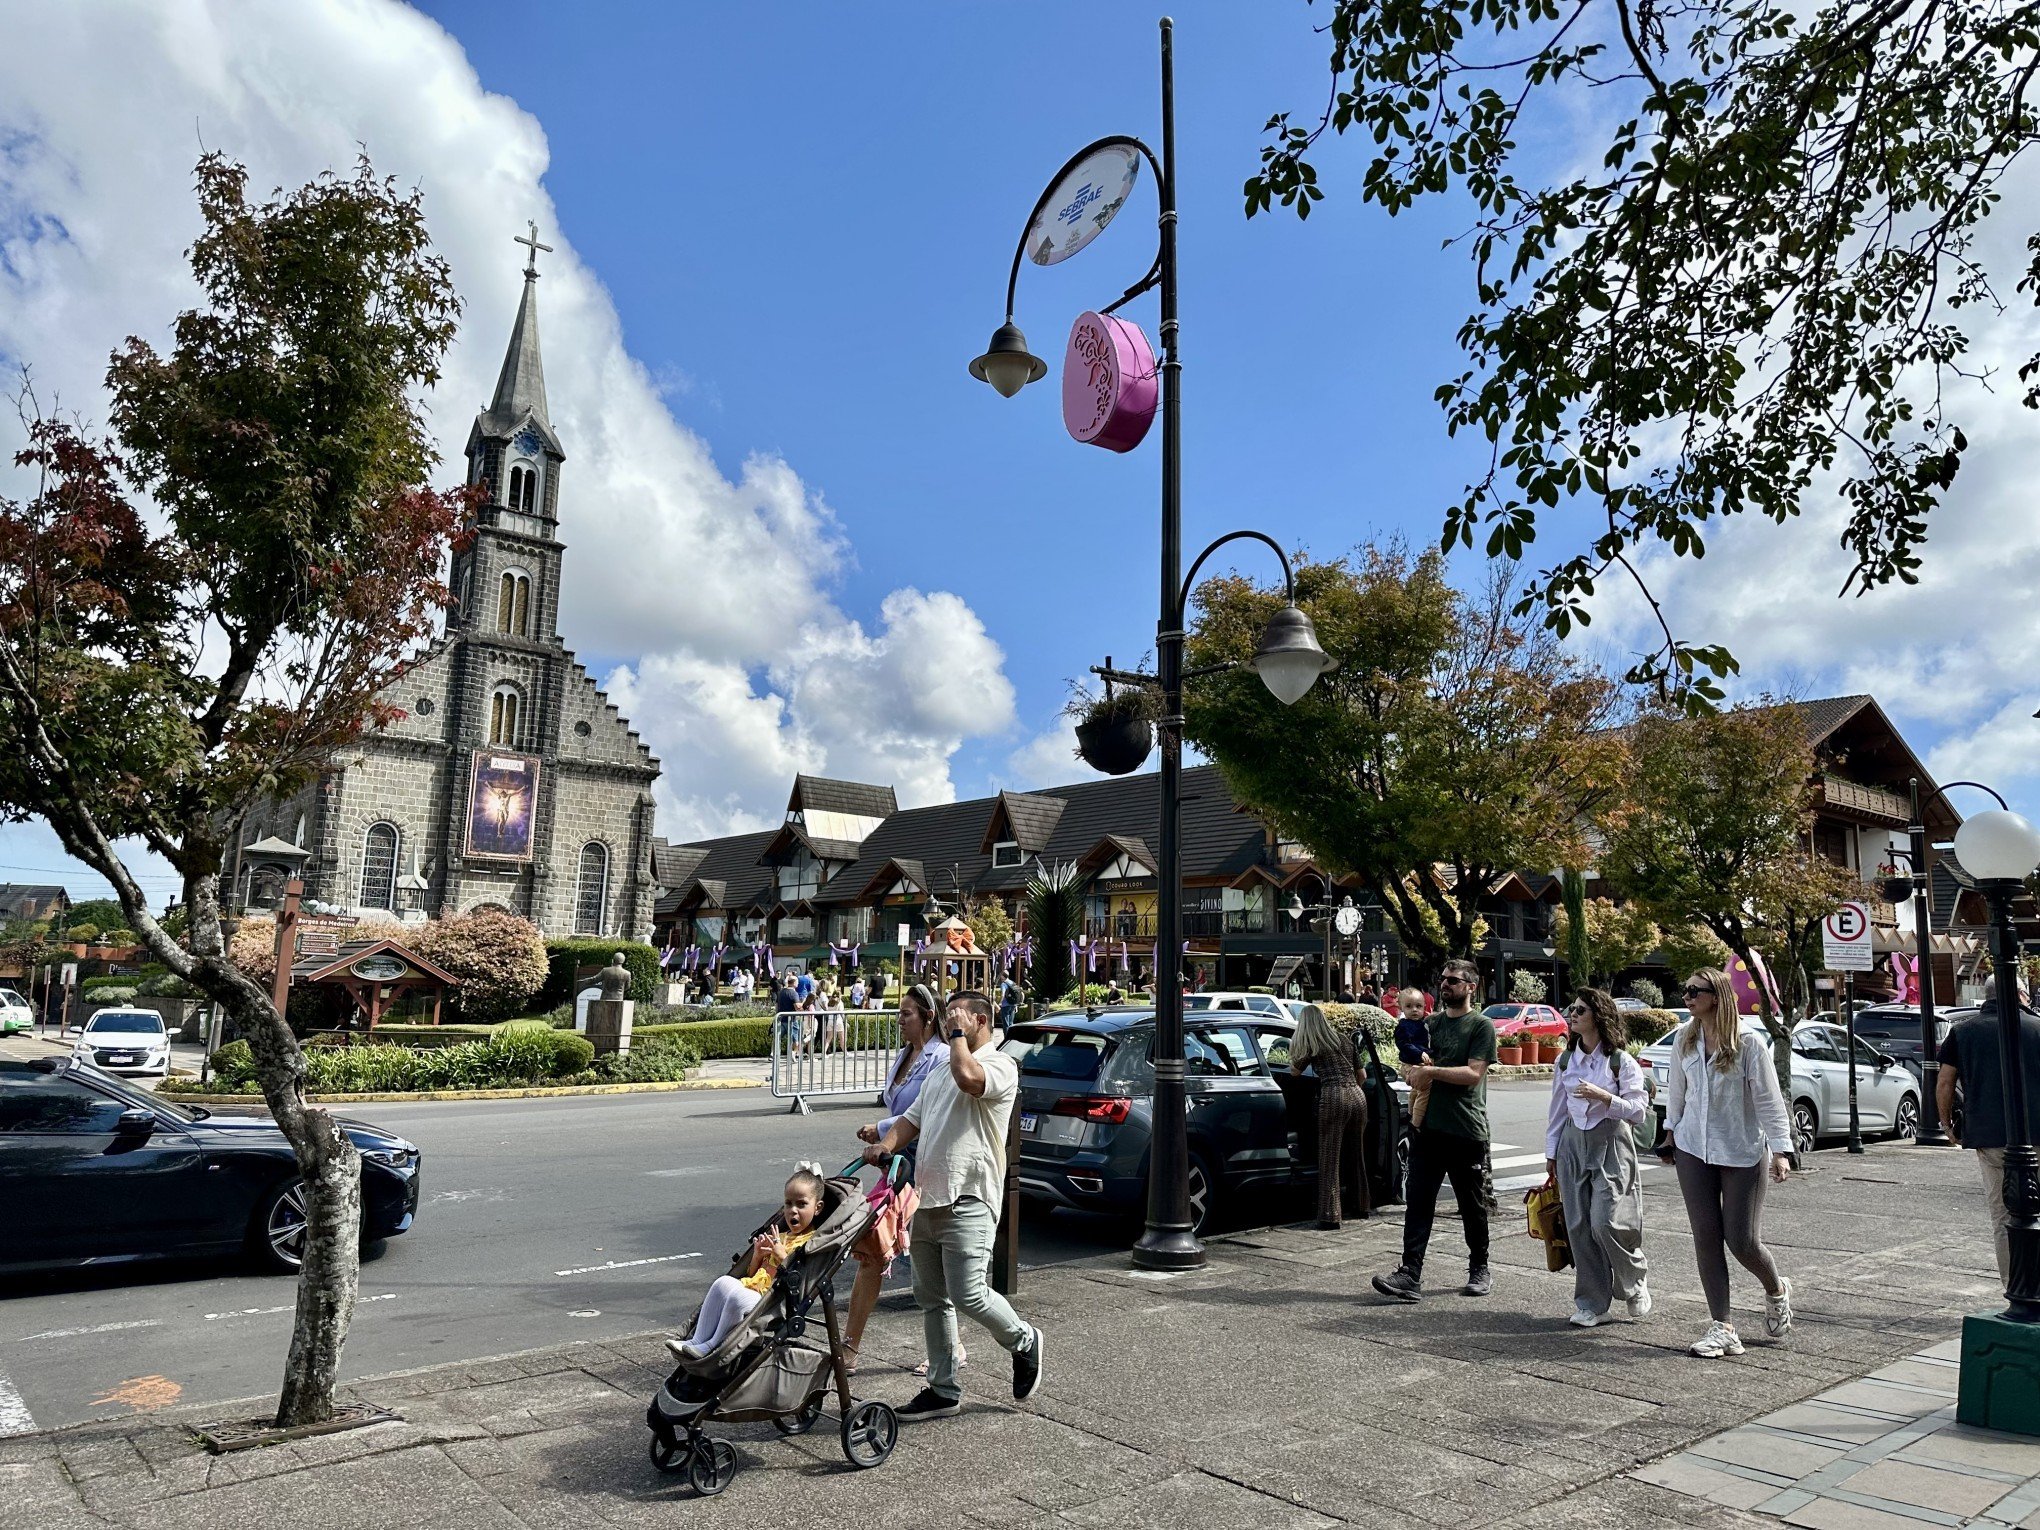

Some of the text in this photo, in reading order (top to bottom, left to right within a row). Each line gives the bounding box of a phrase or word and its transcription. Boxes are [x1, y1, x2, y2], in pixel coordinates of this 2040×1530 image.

[1058, 185, 1104, 222] SEBRAE
[297, 917, 319, 925] Borges
[328, 920, 355, 928] Medeiros
[1839, 911, 1853, 933] E
